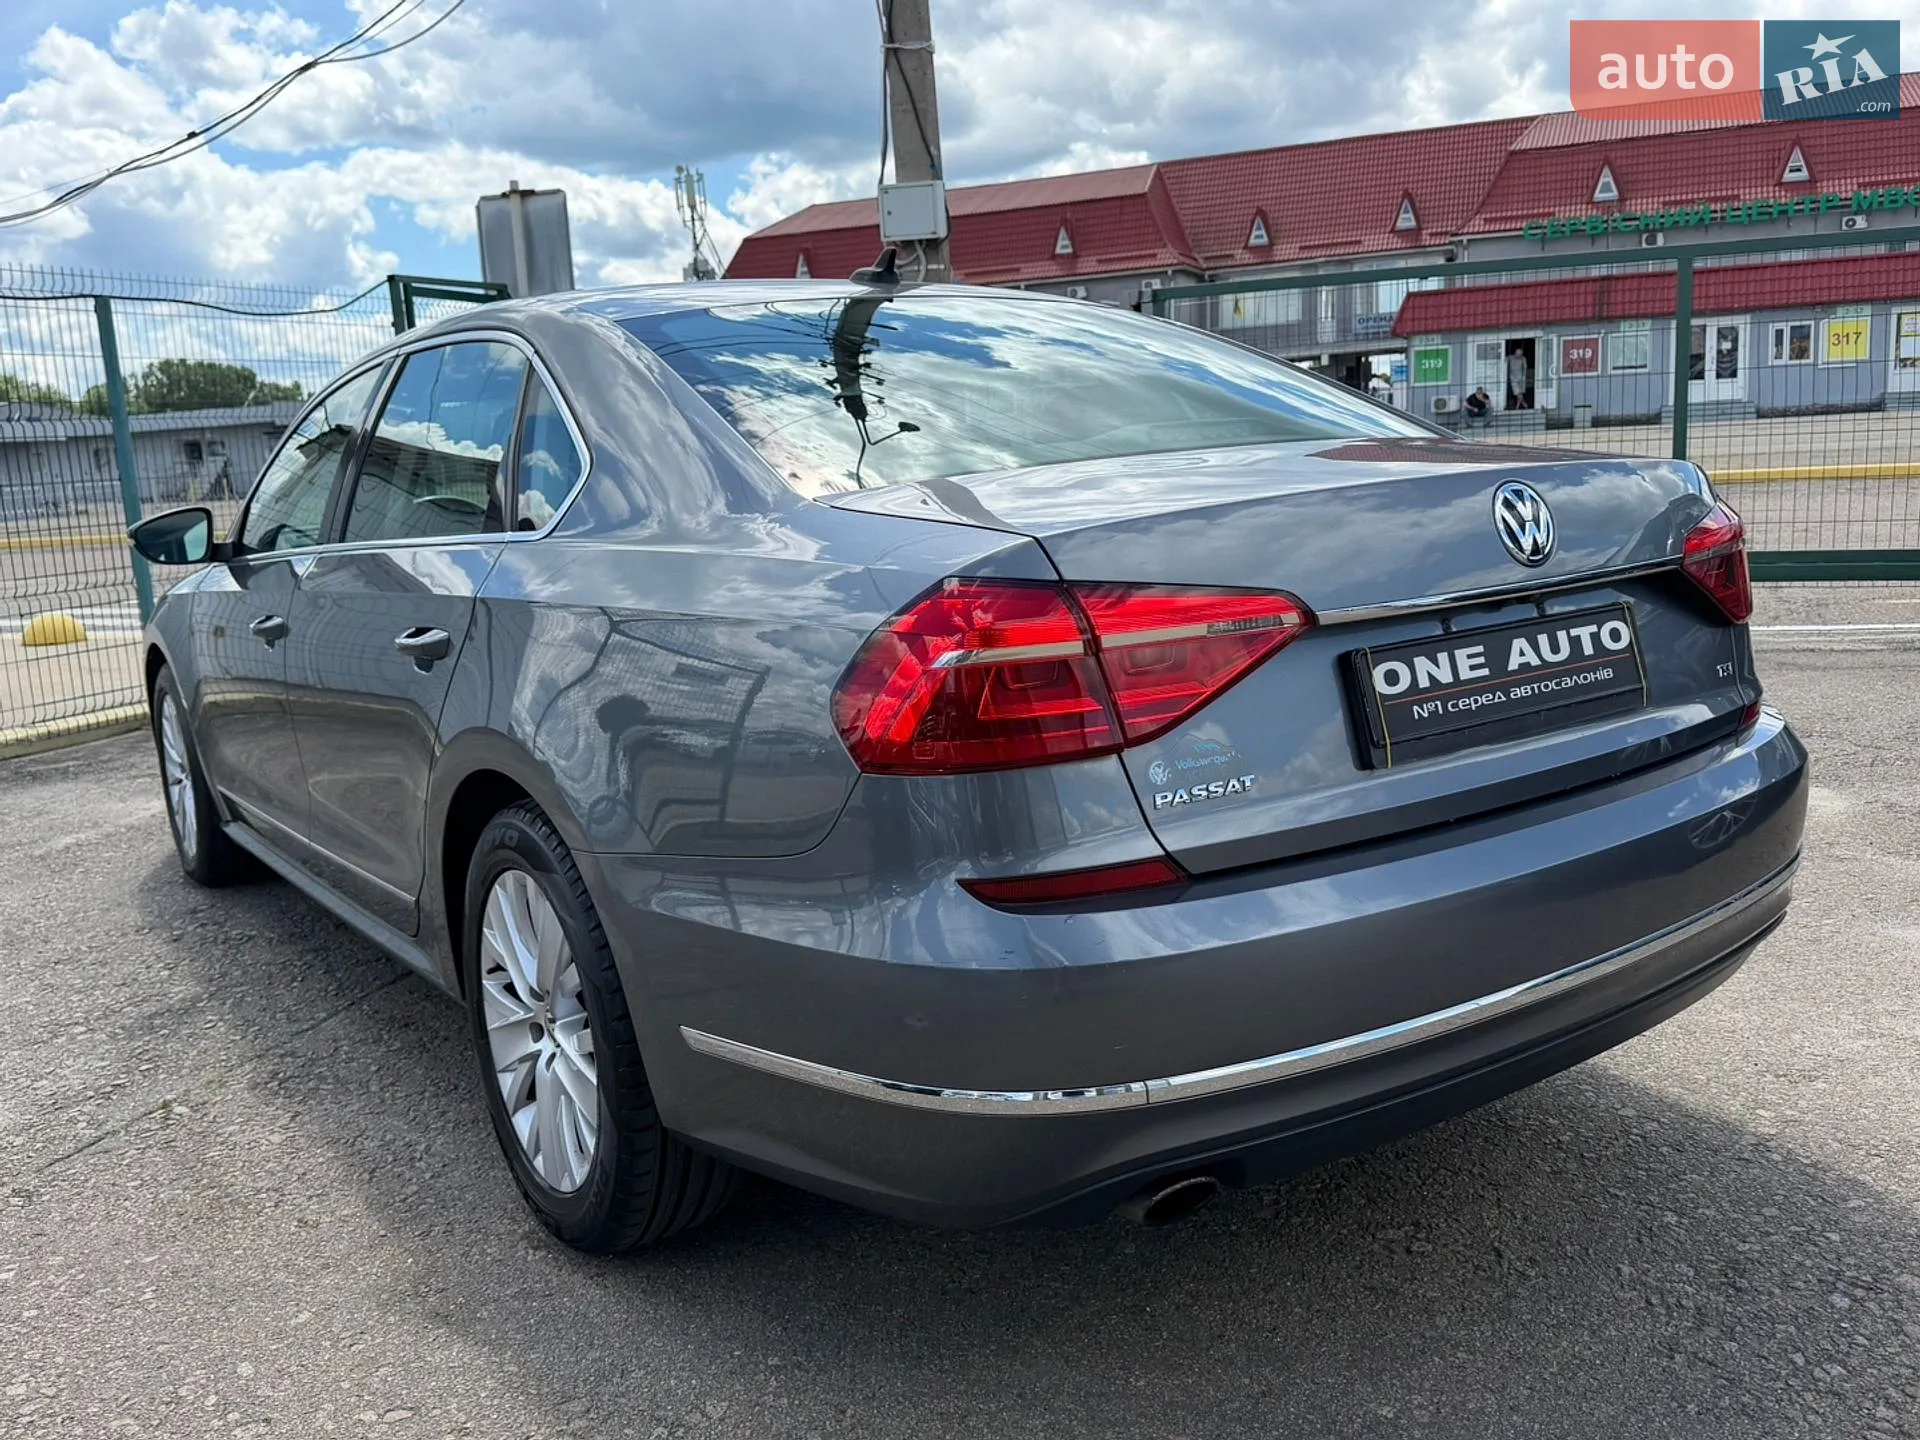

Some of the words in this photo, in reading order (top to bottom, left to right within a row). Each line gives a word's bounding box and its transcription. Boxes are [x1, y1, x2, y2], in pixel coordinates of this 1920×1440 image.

[1726, 193, 1841, 226] ЦЕНТР
[1568, 348, 1593, 360] 319
[1831, 331, 1862, 347] 317
[1420, 359, 1443, 369] 319
[1373, 645, 1490, 695] ONE
[1507, 620, 1631, 671] AUTO
[1412, 694, 1443, 720] №1
[1447, 690, 1506, 713] серед
[1510, 666, 1614, 699] автосалонів
[1153, 774, 1256, 810] PASSAT
